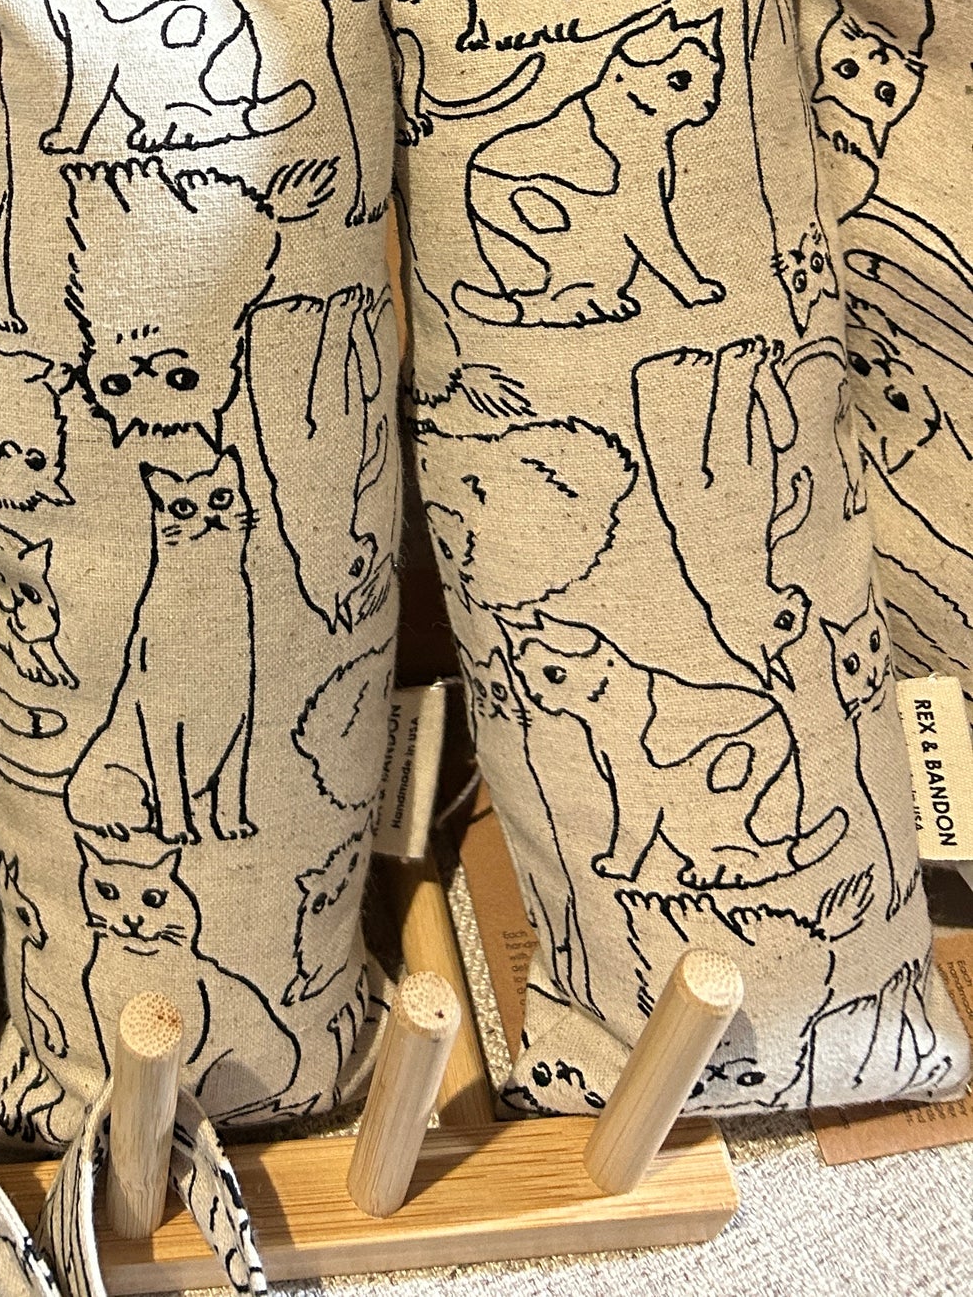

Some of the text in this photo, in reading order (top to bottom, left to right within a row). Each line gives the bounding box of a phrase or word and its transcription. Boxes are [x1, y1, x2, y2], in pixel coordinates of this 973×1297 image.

[391, 716, 420, 829] Handmade in USA
[913, 699, 958, 846] REX & BANDON
[503, 930, 528, 940] Each
[506, 941, 540, 950] handm
[956, 959, 973, 987] Each
